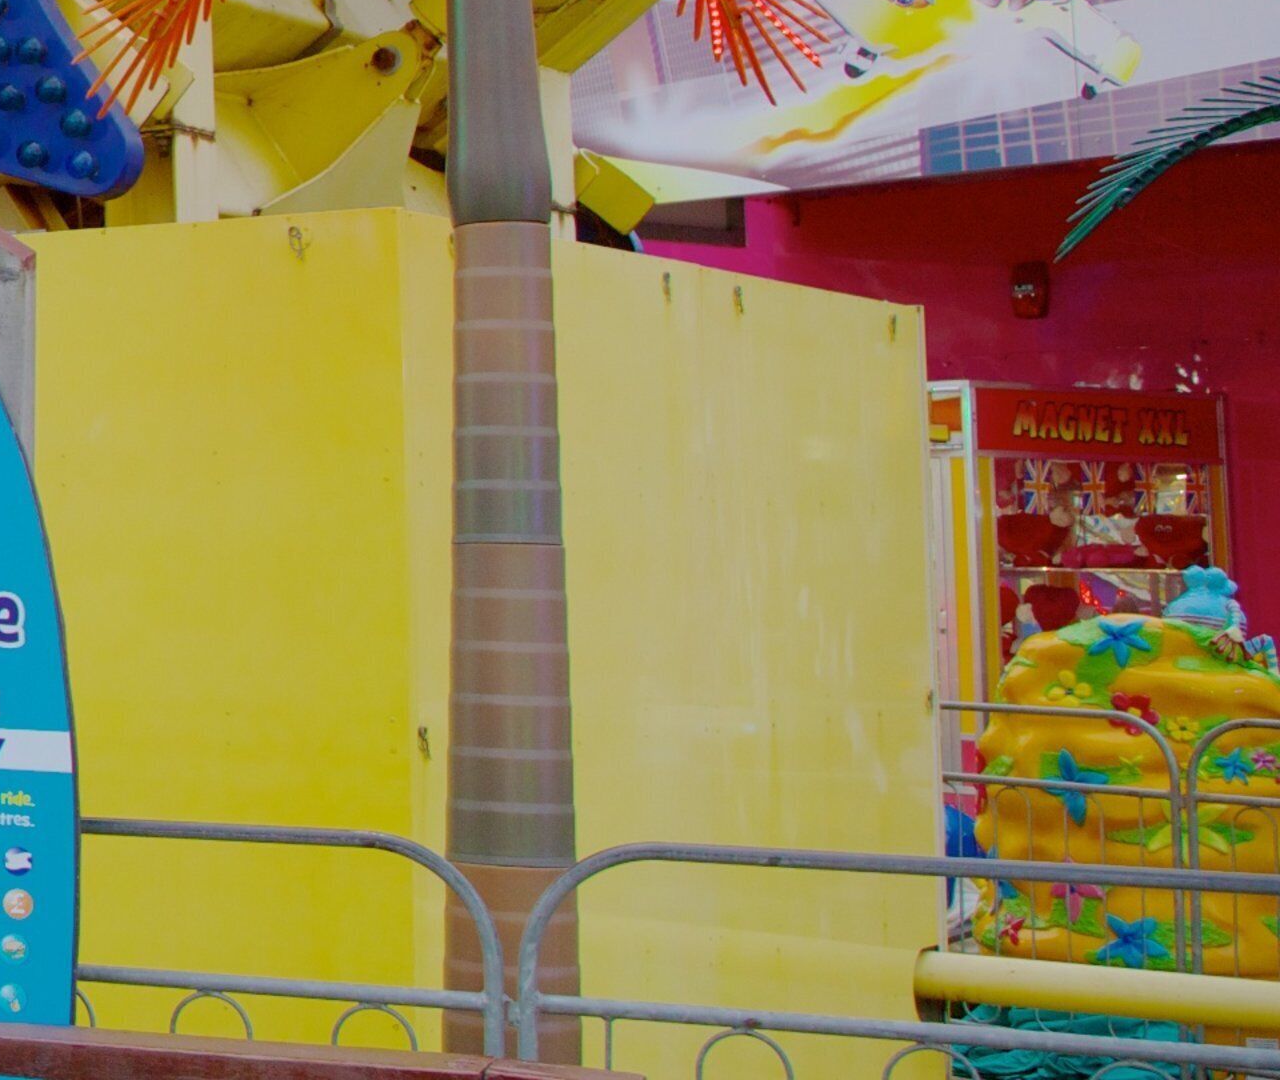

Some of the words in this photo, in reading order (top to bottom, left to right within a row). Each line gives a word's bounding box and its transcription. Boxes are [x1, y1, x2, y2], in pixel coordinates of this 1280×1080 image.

[1012, 400, 1127, 445] MAGNET
[1138, 409, 1188, 447] XXL
[0, 791, 36, 808] ride.
